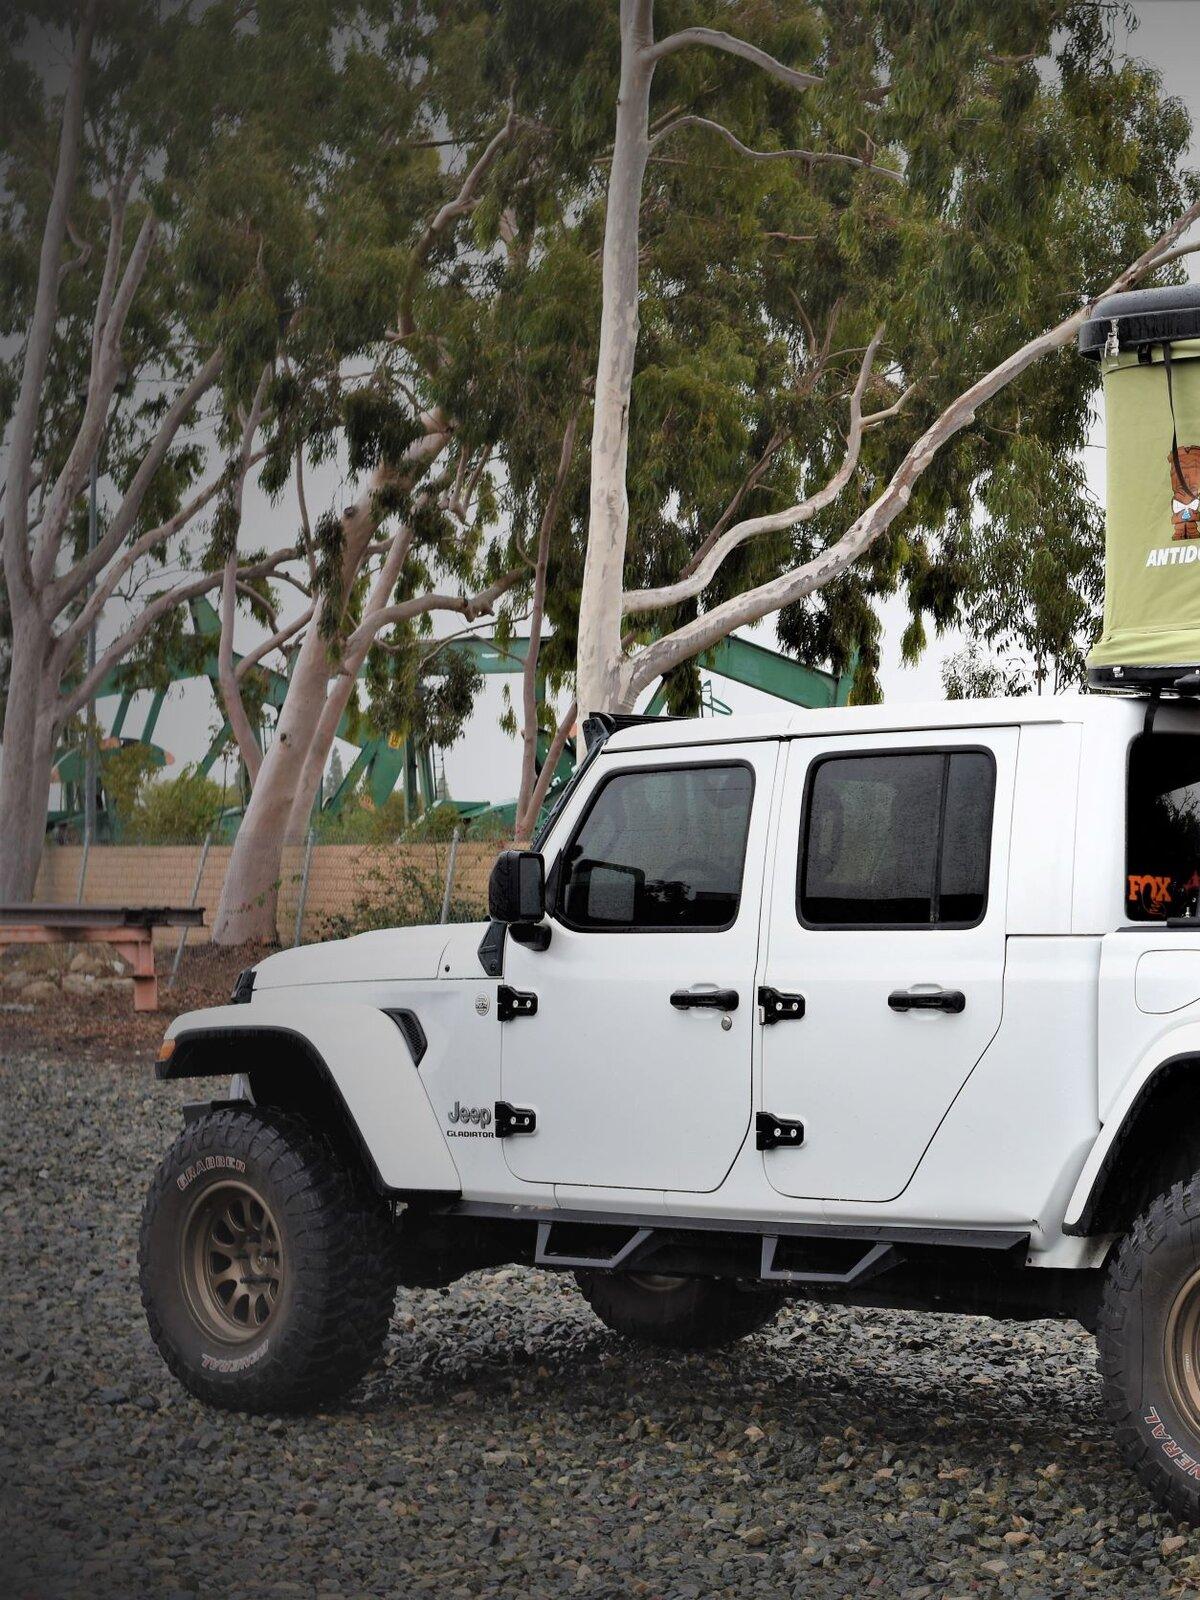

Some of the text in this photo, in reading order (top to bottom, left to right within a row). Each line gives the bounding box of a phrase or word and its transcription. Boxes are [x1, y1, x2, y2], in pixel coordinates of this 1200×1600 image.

[1128, 874, 1172, 903] FOX
[447, 1100, 492, 1130] Jeep
[446, 1130, 495, 1139] GLADIATOR
[176, 1154, 246, 1191] GRABBER
